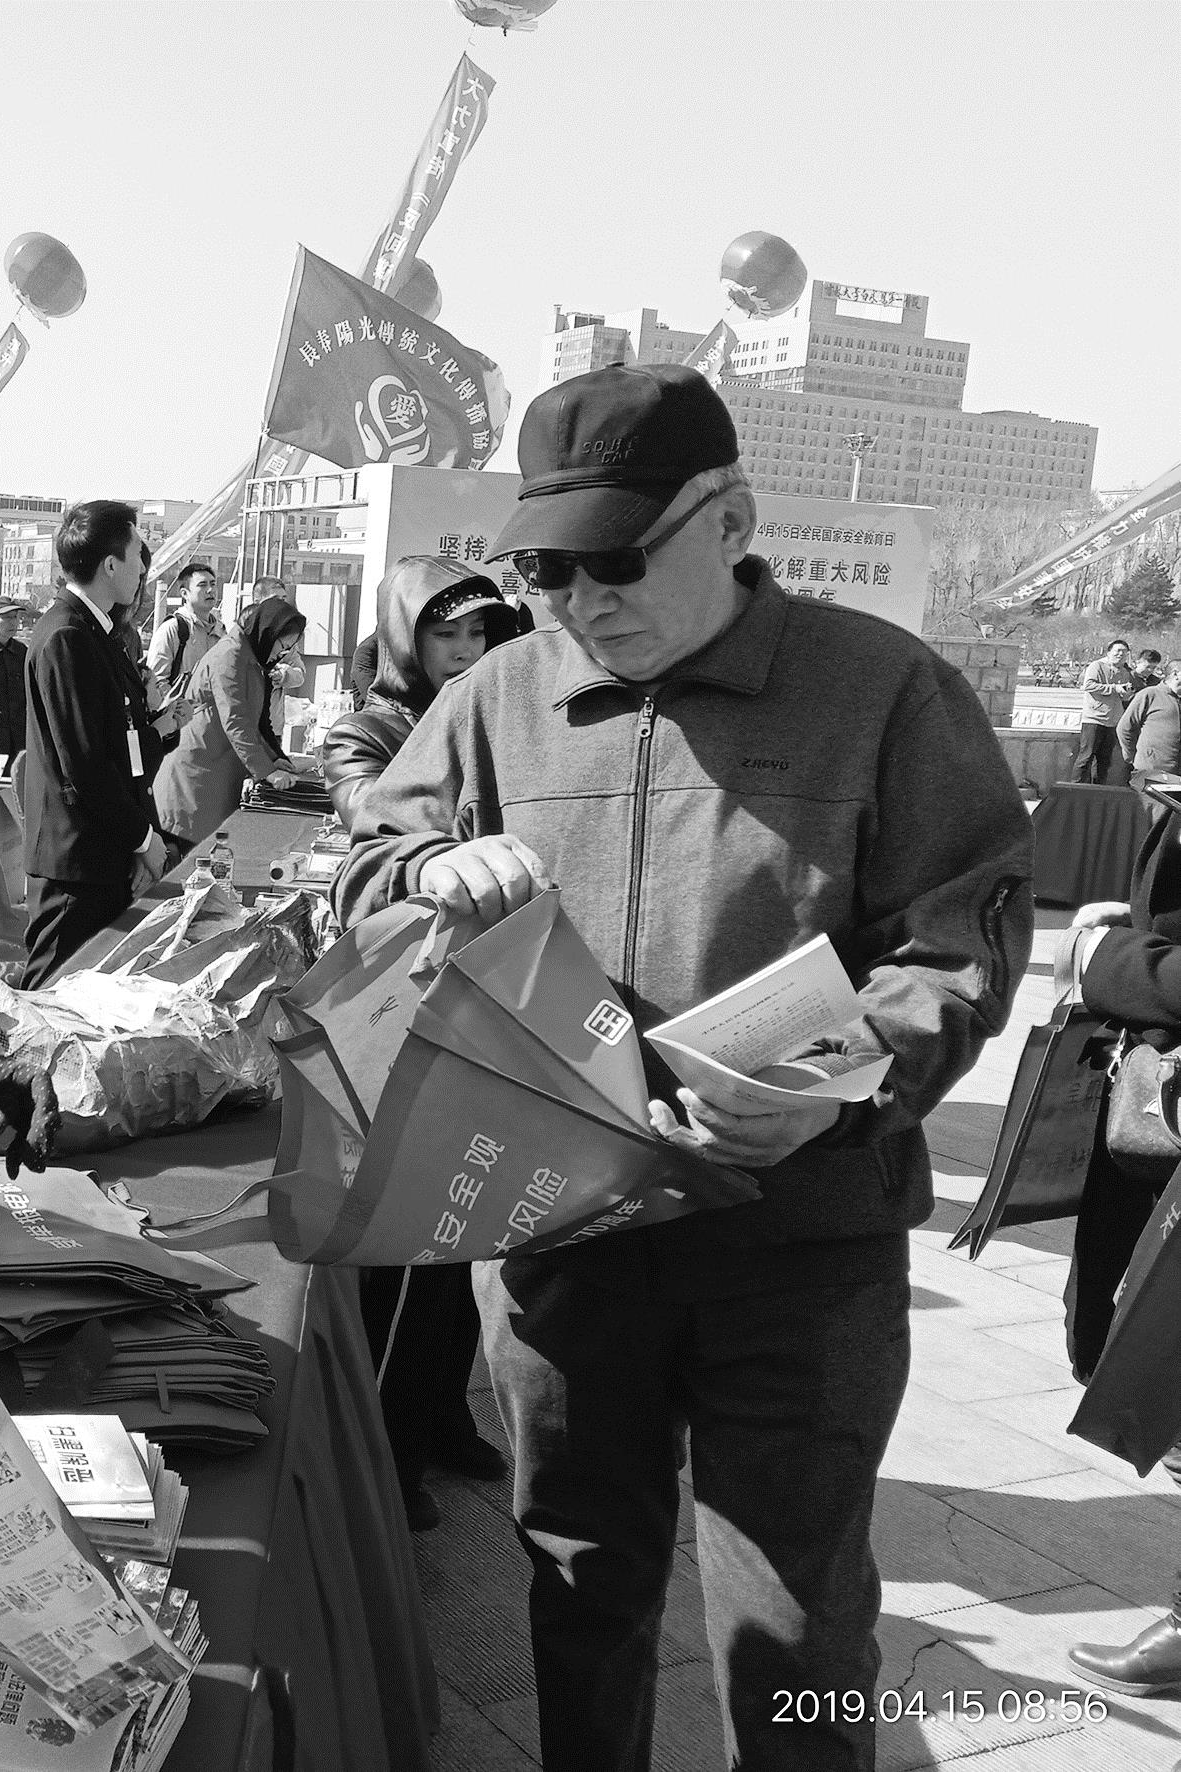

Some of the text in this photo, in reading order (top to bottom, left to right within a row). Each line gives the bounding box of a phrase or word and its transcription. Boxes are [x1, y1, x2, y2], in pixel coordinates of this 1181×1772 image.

[757, 524, 895, 546] 4月15日全民国家安全教育日
[438, 534, 486, 561] 坚持
